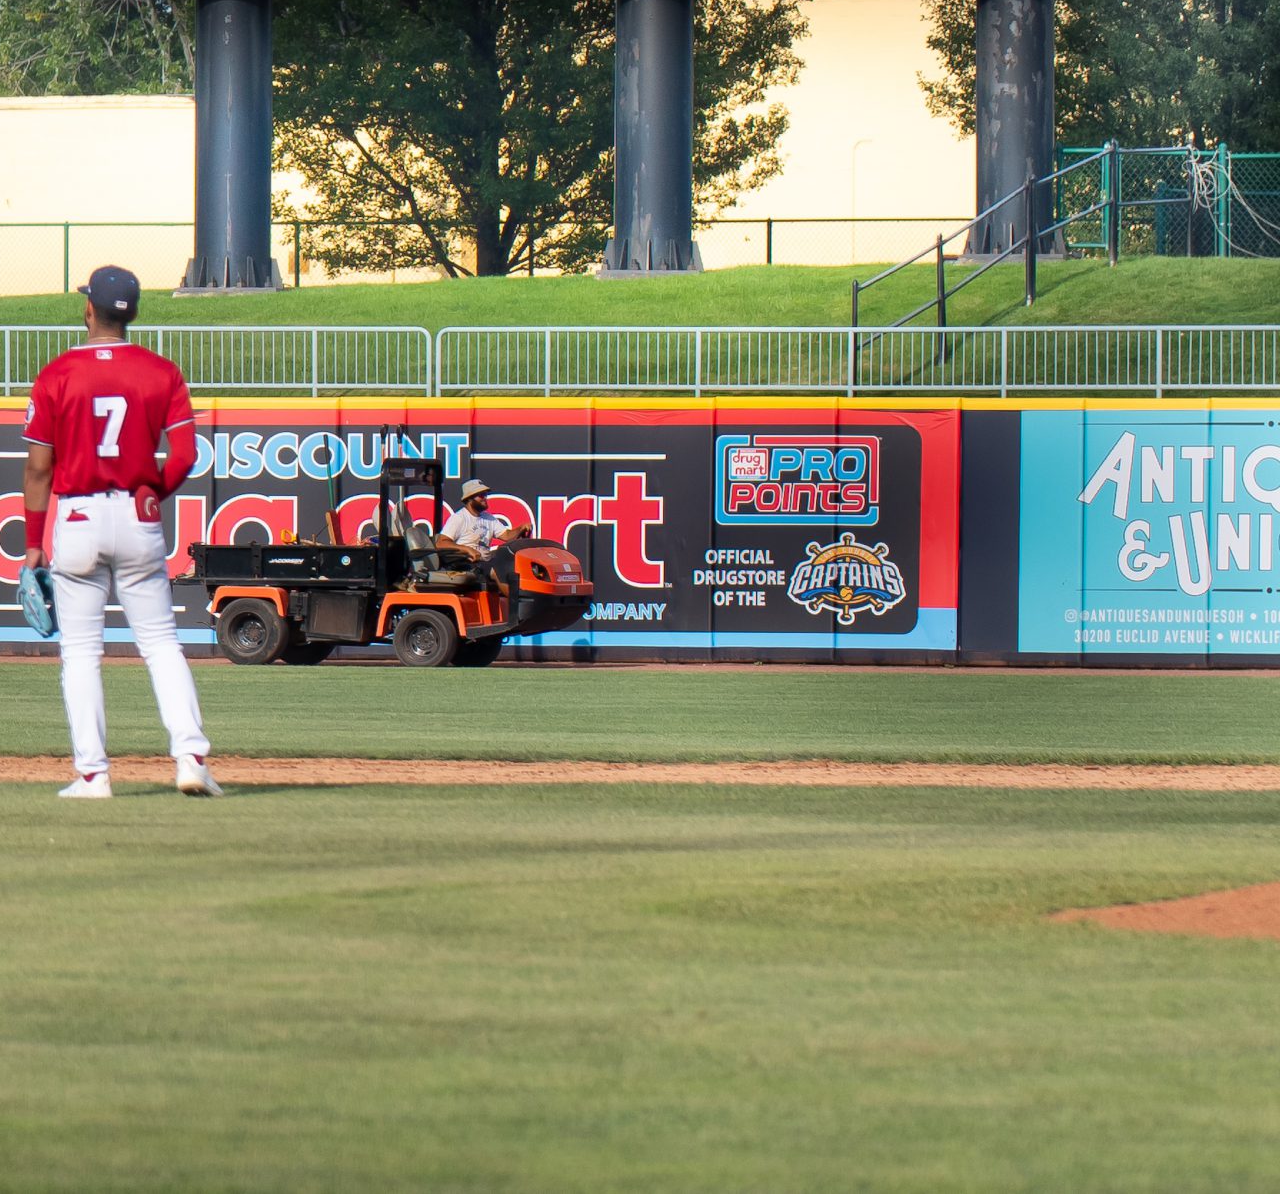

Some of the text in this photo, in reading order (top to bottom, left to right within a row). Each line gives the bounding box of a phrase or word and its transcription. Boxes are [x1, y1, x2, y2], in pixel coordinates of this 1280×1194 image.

[92, 394, 128, 458] 7
[733, 449, 761, 466] drug
[770, 447, 867, 482] PRO
[735, 465, 767, 475] mart
[728, 482, 867, 513] POINTS
[705, 549, 774, 565] OFFICIAL
[1168, 510, 1280, 596] UNI
[693, 570, 786, 586] DRUGSTORE
[793, 562, 901, 596] CAPTAINS
[713, 591, 766, 606] OF THE
[582, 602, 667, 621] OMPANY
[1074, 629, 1111, 644] 30200
[1116, 629, 1159, 644] EUCLID
[1164, 629, 1210, 644] AVENUE
